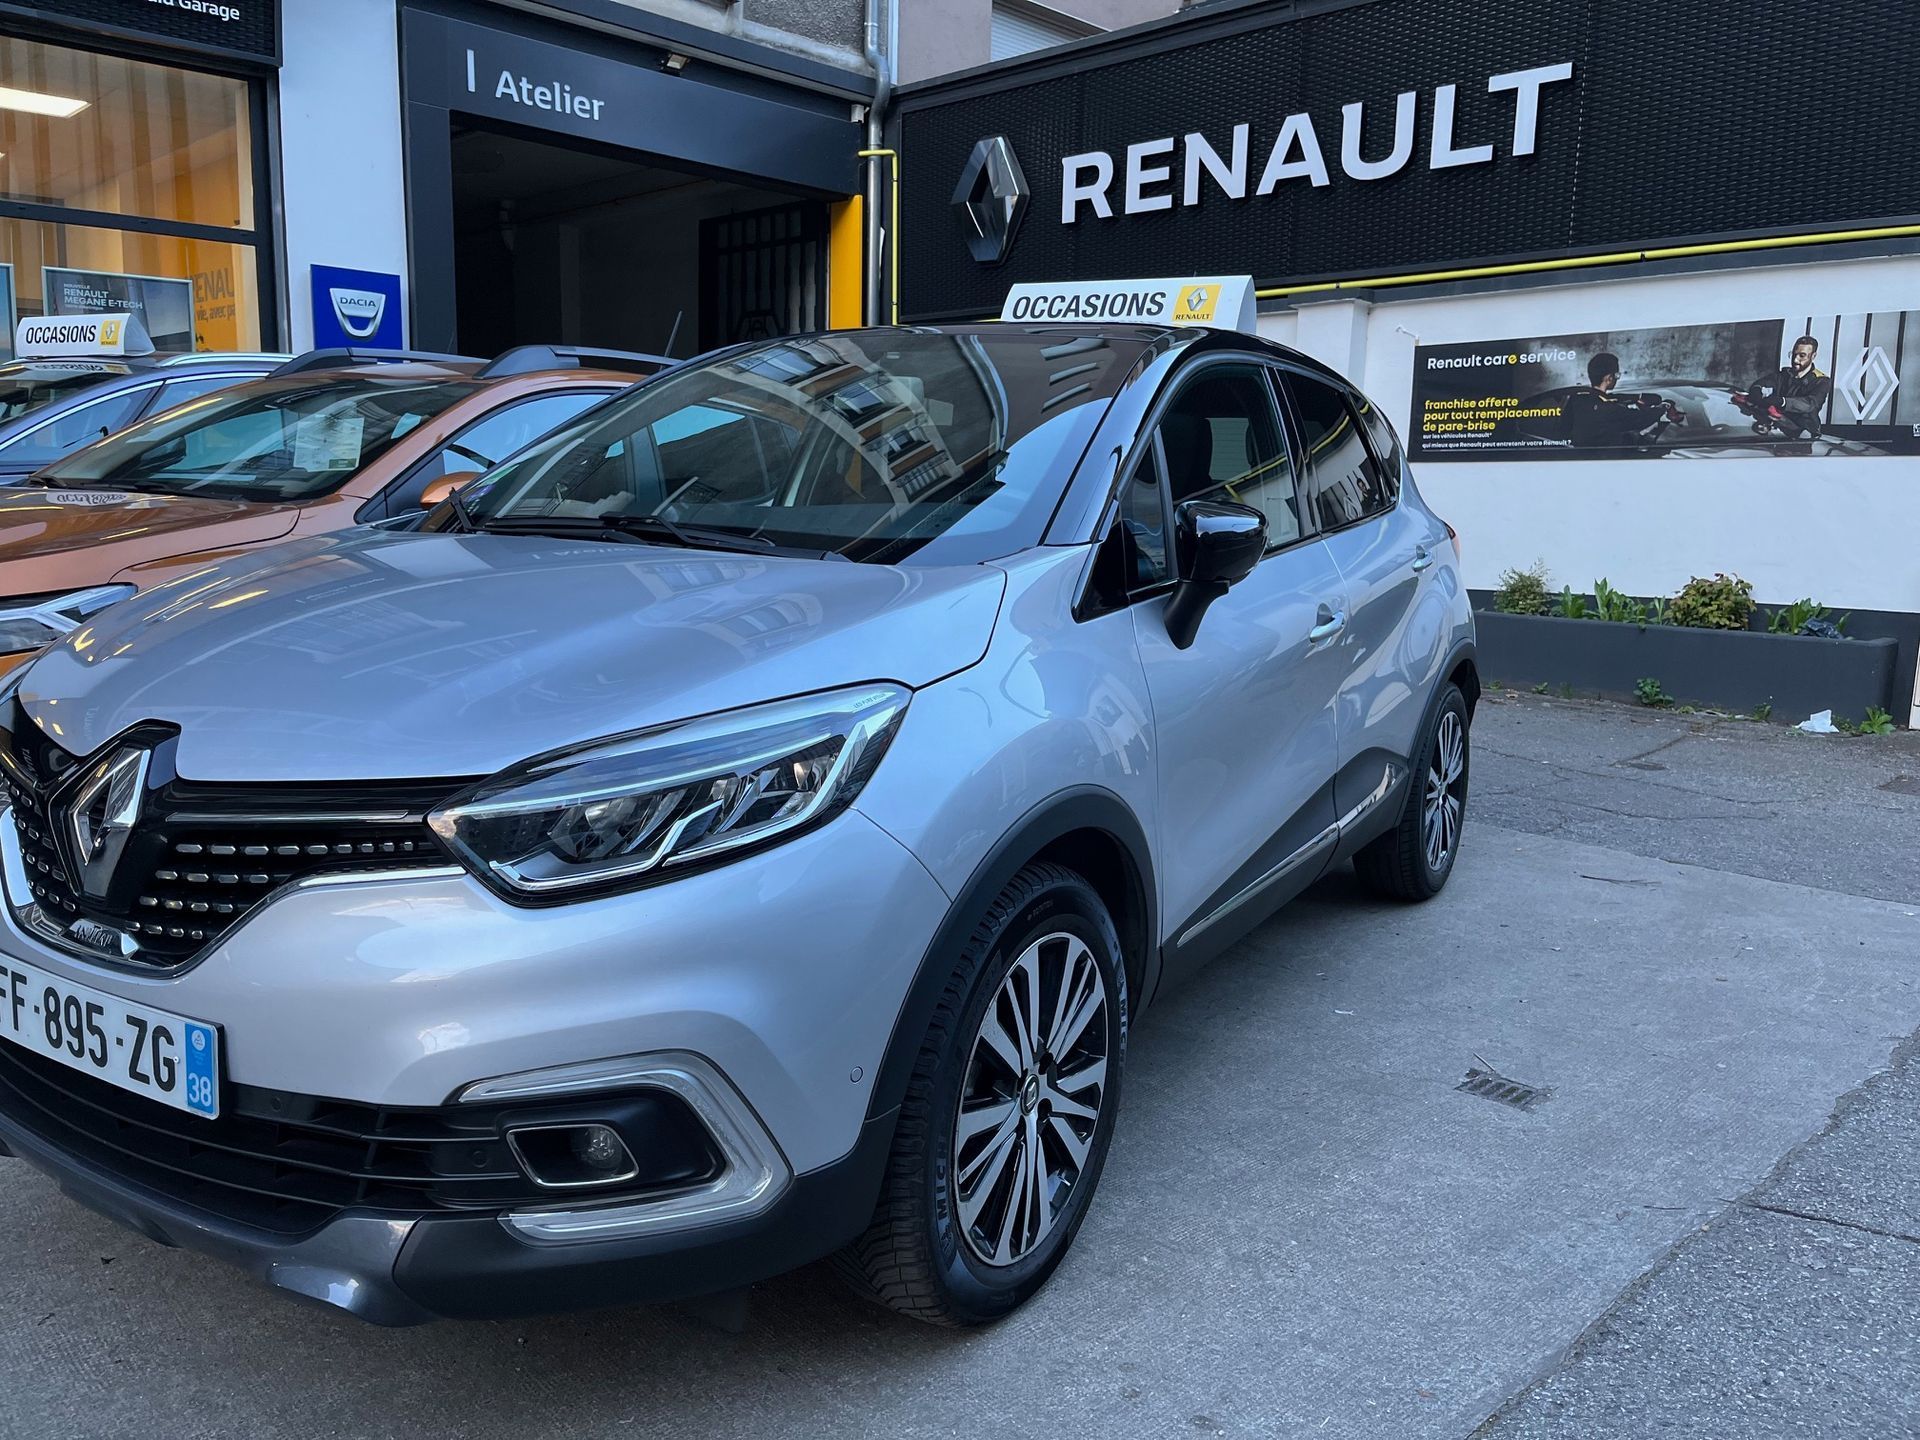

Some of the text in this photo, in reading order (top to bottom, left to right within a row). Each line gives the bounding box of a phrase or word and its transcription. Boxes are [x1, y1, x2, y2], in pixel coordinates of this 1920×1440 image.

[178, 0, 240, 21] Garage
[495, 70, 605, 121] Atelier
[1060, 61, 1574, 225] RENAULT
[63, 288, 109, 299] RENAULT
[340, 297, 377, 308] DACIA
[64, 296, 107, 307] MEGANE
[108, 299, 143, 310] E-TECH
[1012, 291, 1167, 320] OCCASIONS
[1175, 312, 1212, 321] RENAULT
[25, 325, 97, 345] OCCASIONS
[1427, 348, 1577, 370] Renault care service
[1425, 397, 1519, 410] franchise offerte
[1424, 407, 1561, 423] pour tout remplacement
[1422, 420, 1496, 433] de pare-brise
[188, 1072, 212, 1107] 38
